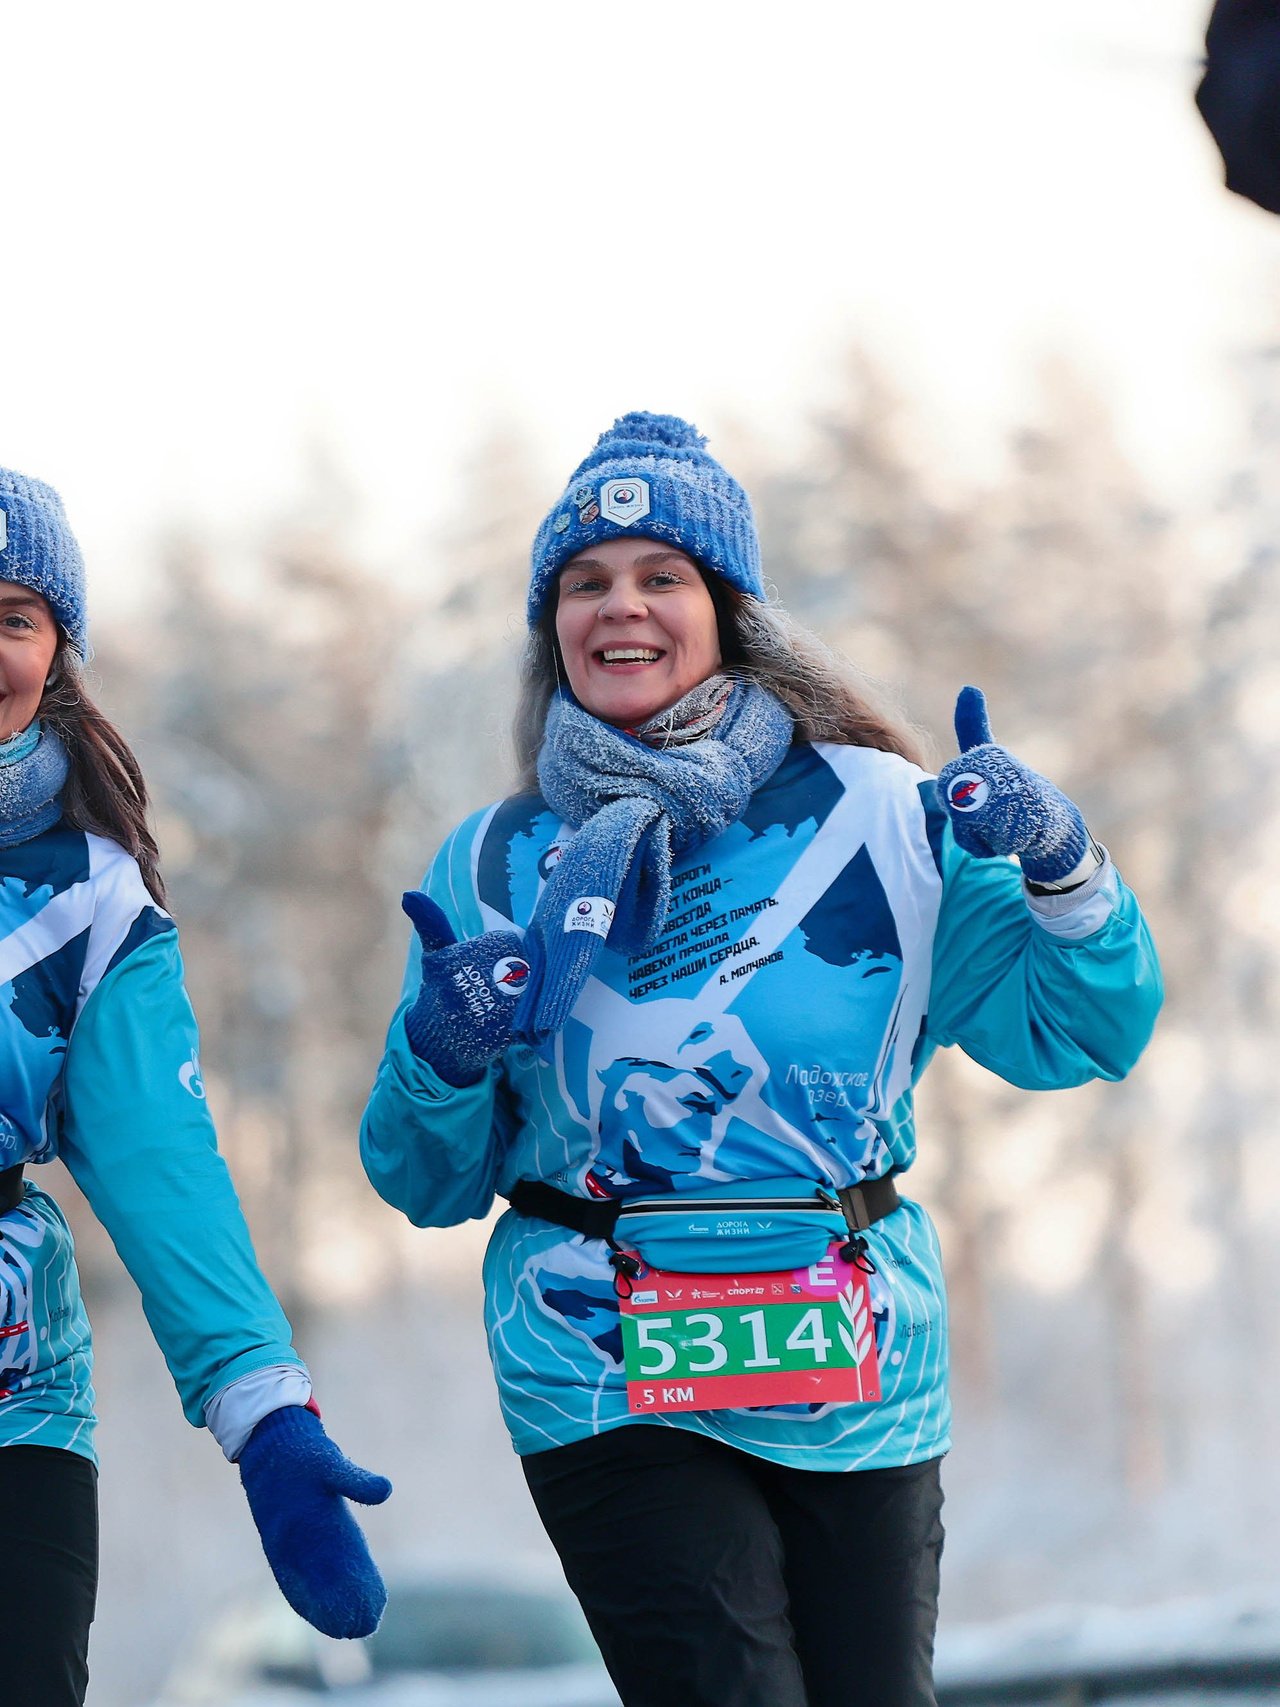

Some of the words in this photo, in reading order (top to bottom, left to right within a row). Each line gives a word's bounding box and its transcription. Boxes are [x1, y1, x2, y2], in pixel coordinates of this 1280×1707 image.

[682, 877, 722, 905] КОНЦА
[691, 913, 729, 938] ЧЕРЕЗ
[628, 953, 676, 984] НАВЕКИ
[679, 932, 730, 960] ПРОШЛА
[629, 975, 669, 999] ЧЕРЕЗ
[671, 956, 708, 982] НАШИ
[709, 936, 761, 966] СЕРДЦА.
[720, 974, 730, 985] А.
[731, 950, 785, 981] МОЛЧАНОВ
[452, 970, 486, 1018] ЖИЗНИ
[462, 962, 496, 1012] ДОРОГА
[785, 1064, 869, 1088] Ладожское
[716, 1221, 749, 1229] ДОРОГА
[716, 1228, 750, 1236] ЖИЗНИ
[636, 1307, 833, 1376] 5314
[643, 1388, 656, 1405] 5
